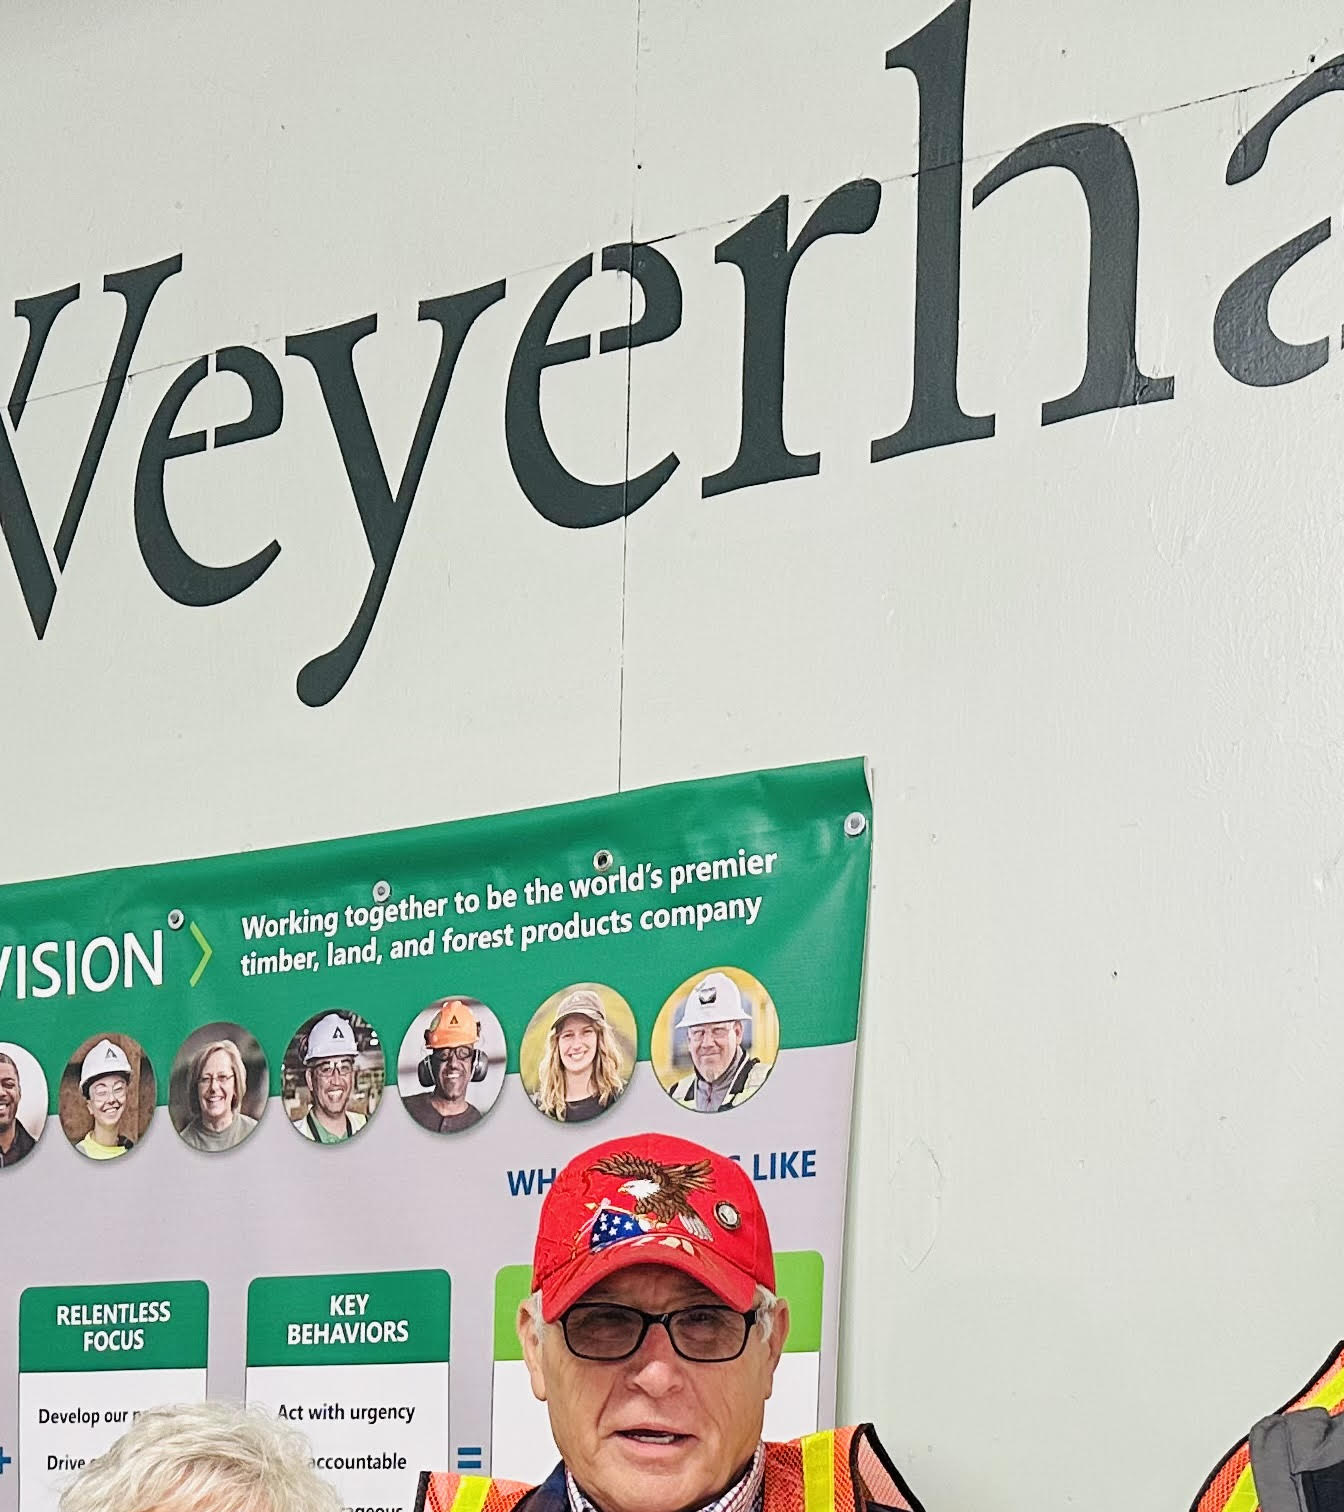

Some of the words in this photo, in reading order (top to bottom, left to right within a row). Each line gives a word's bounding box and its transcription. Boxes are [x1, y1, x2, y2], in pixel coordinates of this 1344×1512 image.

[240, 908, 339, 940] Working
[344, 894, 449, 933] together
[454, 891, 480, 915] to
[486, 884, 517, 912] be
[521, 878, 565, 908] the
[669, 849, 778, 890] premier
[240, 943, 320, 977] timber,
[326, 940, 384, 969] land,
[389, 932, 436, 961] and
[442, 921, 516, 954] forest
[520, 911, 634, 951] products
[639, 896, 763, 934] company
[506, 1167, 557, 1196] WH
[753, 1150, 817, 1181] LIKE
[56, 1300, 172, 1327] RELENTLESS
[329, 1294, 370, 1317] KEY
[82, 1329, 145, 1353] FOCUS
[287, 1319, 409, 1346] BEHAVIORS
[39, 1407, 100, 1429] Develop
[104, 1410, 129, 1423] our
[278, 1404, 304, 1421] Act
[308, 1403, 345, 1421] with
[350, 1405, 416, 1425] urgency
[47, 1454, 86, 1471] Drive
[308, 1452, 407, 1470] accountable
